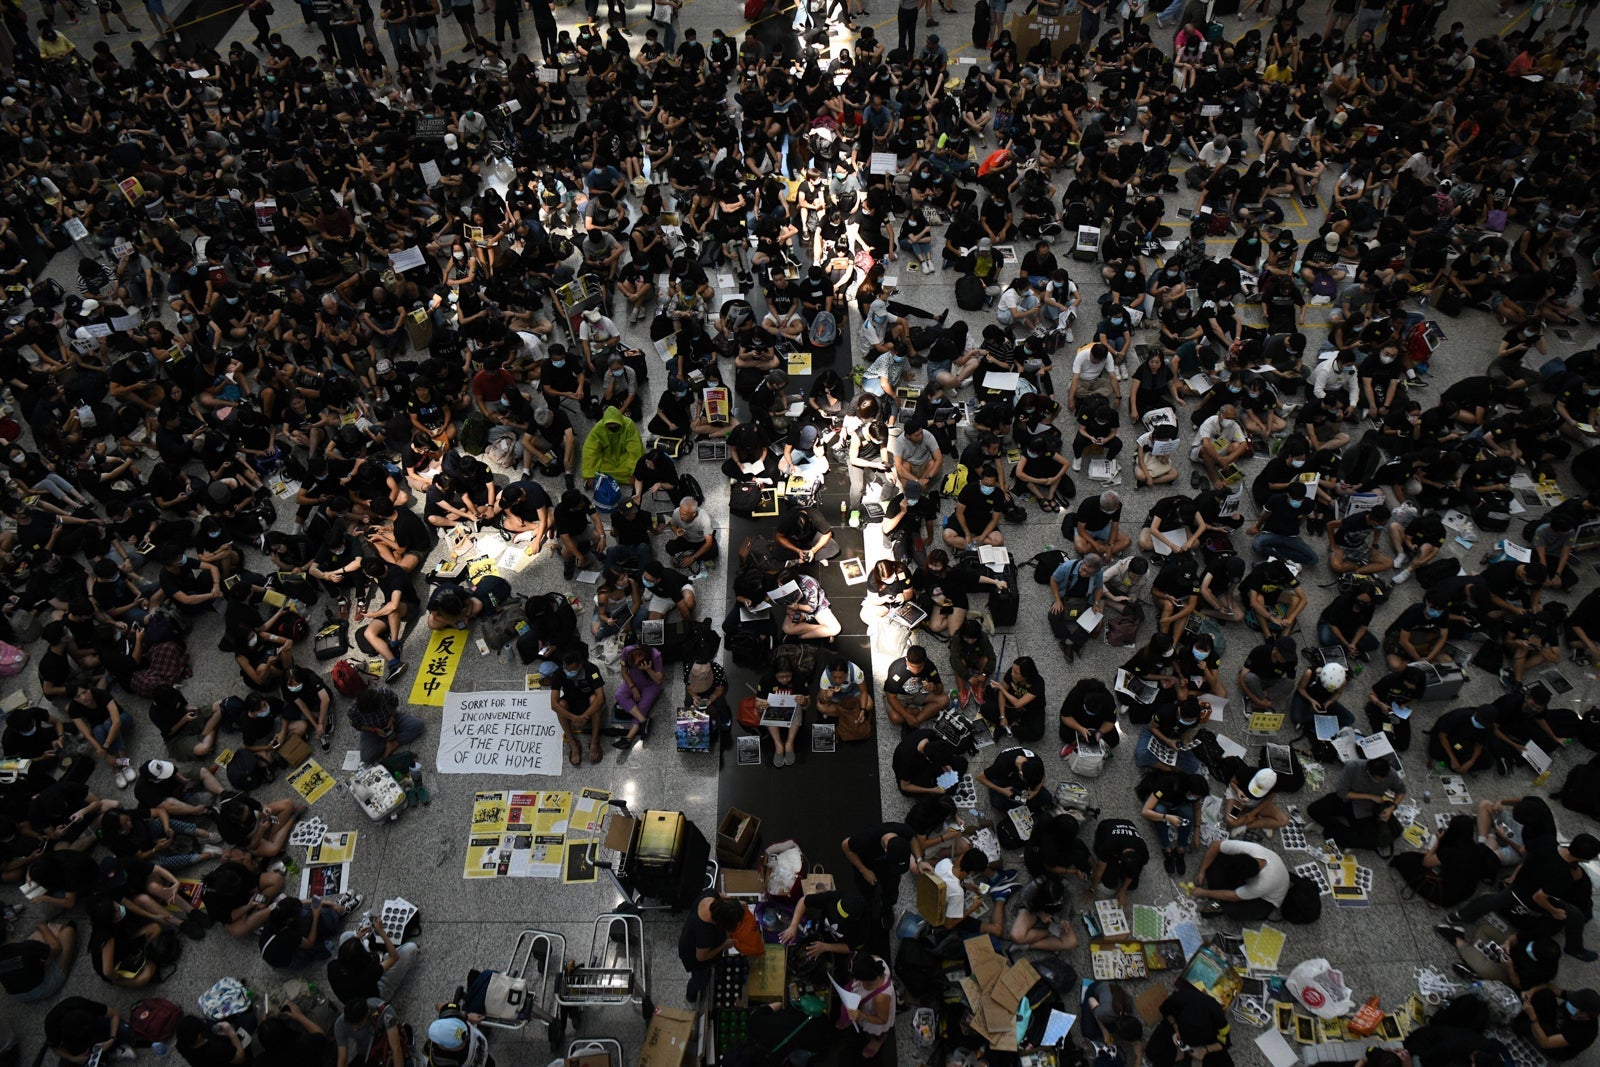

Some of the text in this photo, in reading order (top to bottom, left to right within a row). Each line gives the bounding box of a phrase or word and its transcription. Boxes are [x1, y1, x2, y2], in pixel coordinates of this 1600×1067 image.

[424, 635, 455, 697] 反送中
[461, 698, 528, 710] SORRY FOR THE
[461, 712, 531, 722] INCONVENIENCE
[454, 723, 556, 736] WE ARE FIGHTING
[470, 738, 542, 754] THE FUTURE
[454, 751, 542, 769] OF OUR HOME
